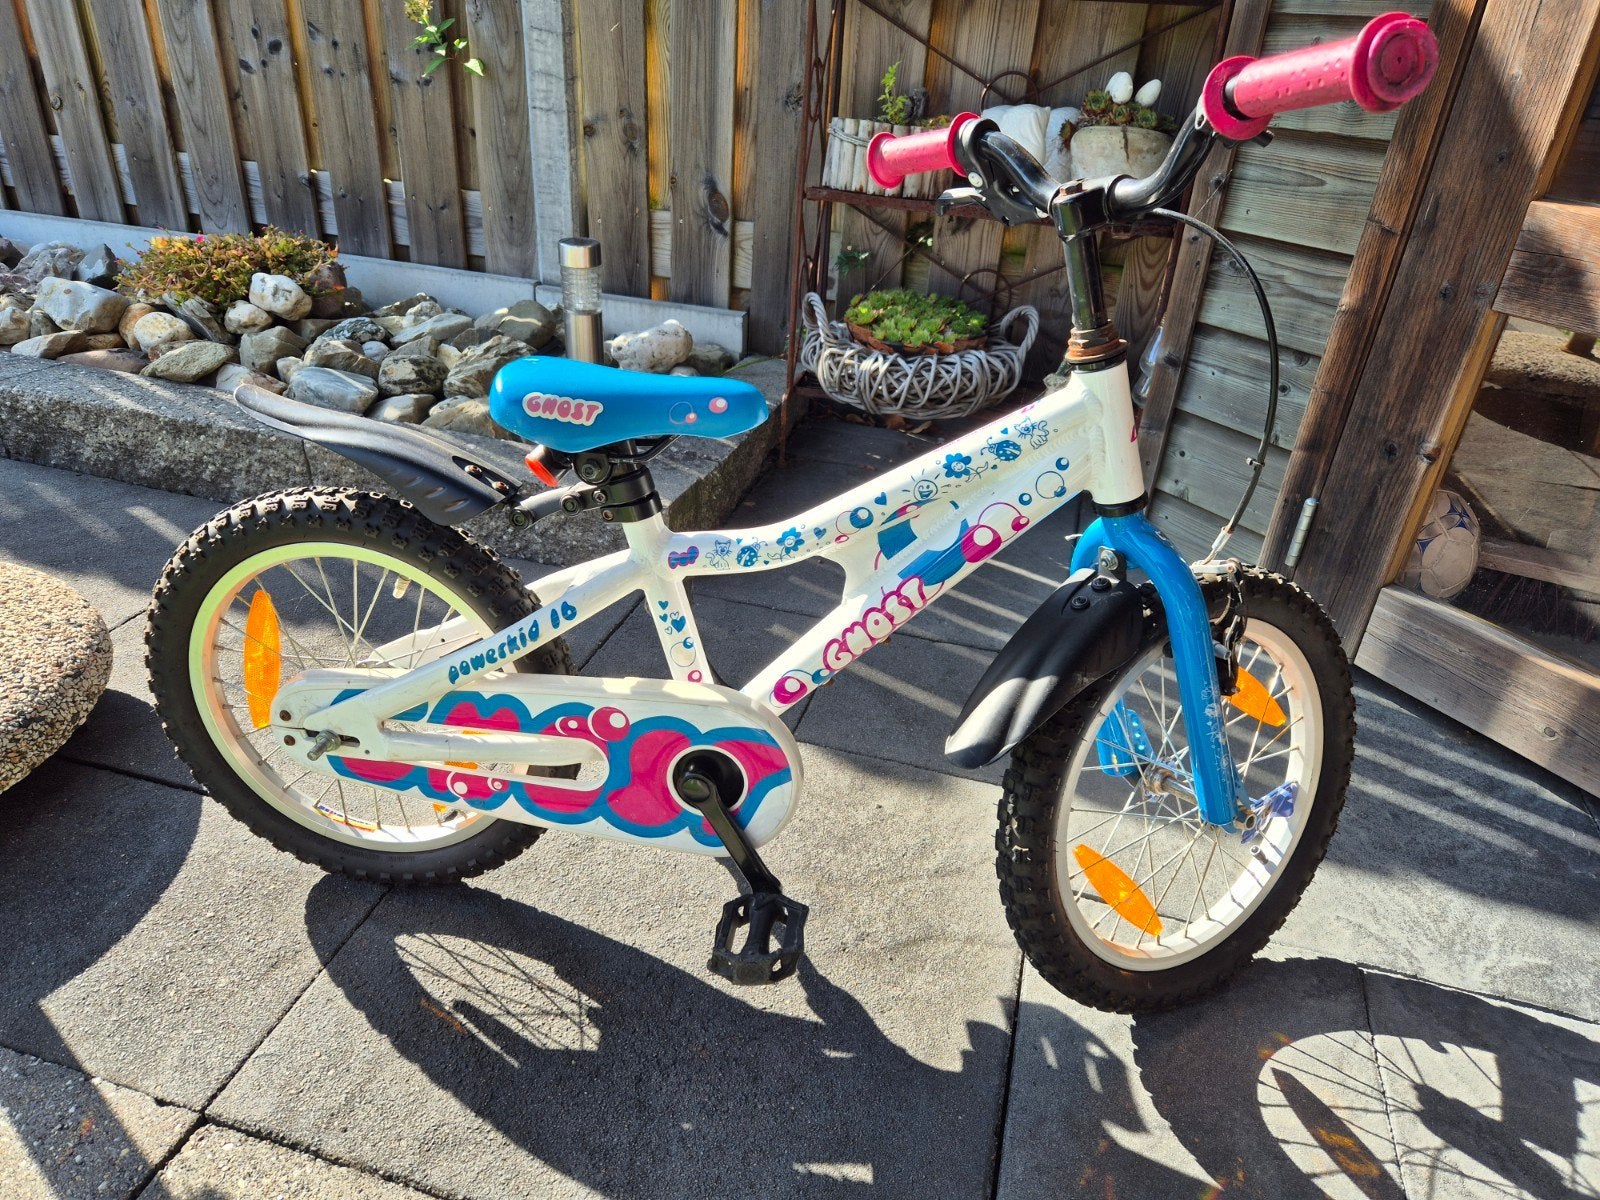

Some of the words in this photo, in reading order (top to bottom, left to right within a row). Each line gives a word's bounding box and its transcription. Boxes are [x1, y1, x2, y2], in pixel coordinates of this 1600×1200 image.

[525, 394, 601, 424] GHOST
[448, 619, 540, 685] powerkid
[550, 601, 578, 630] 16
[823, 575, 927, 672] GHOST
